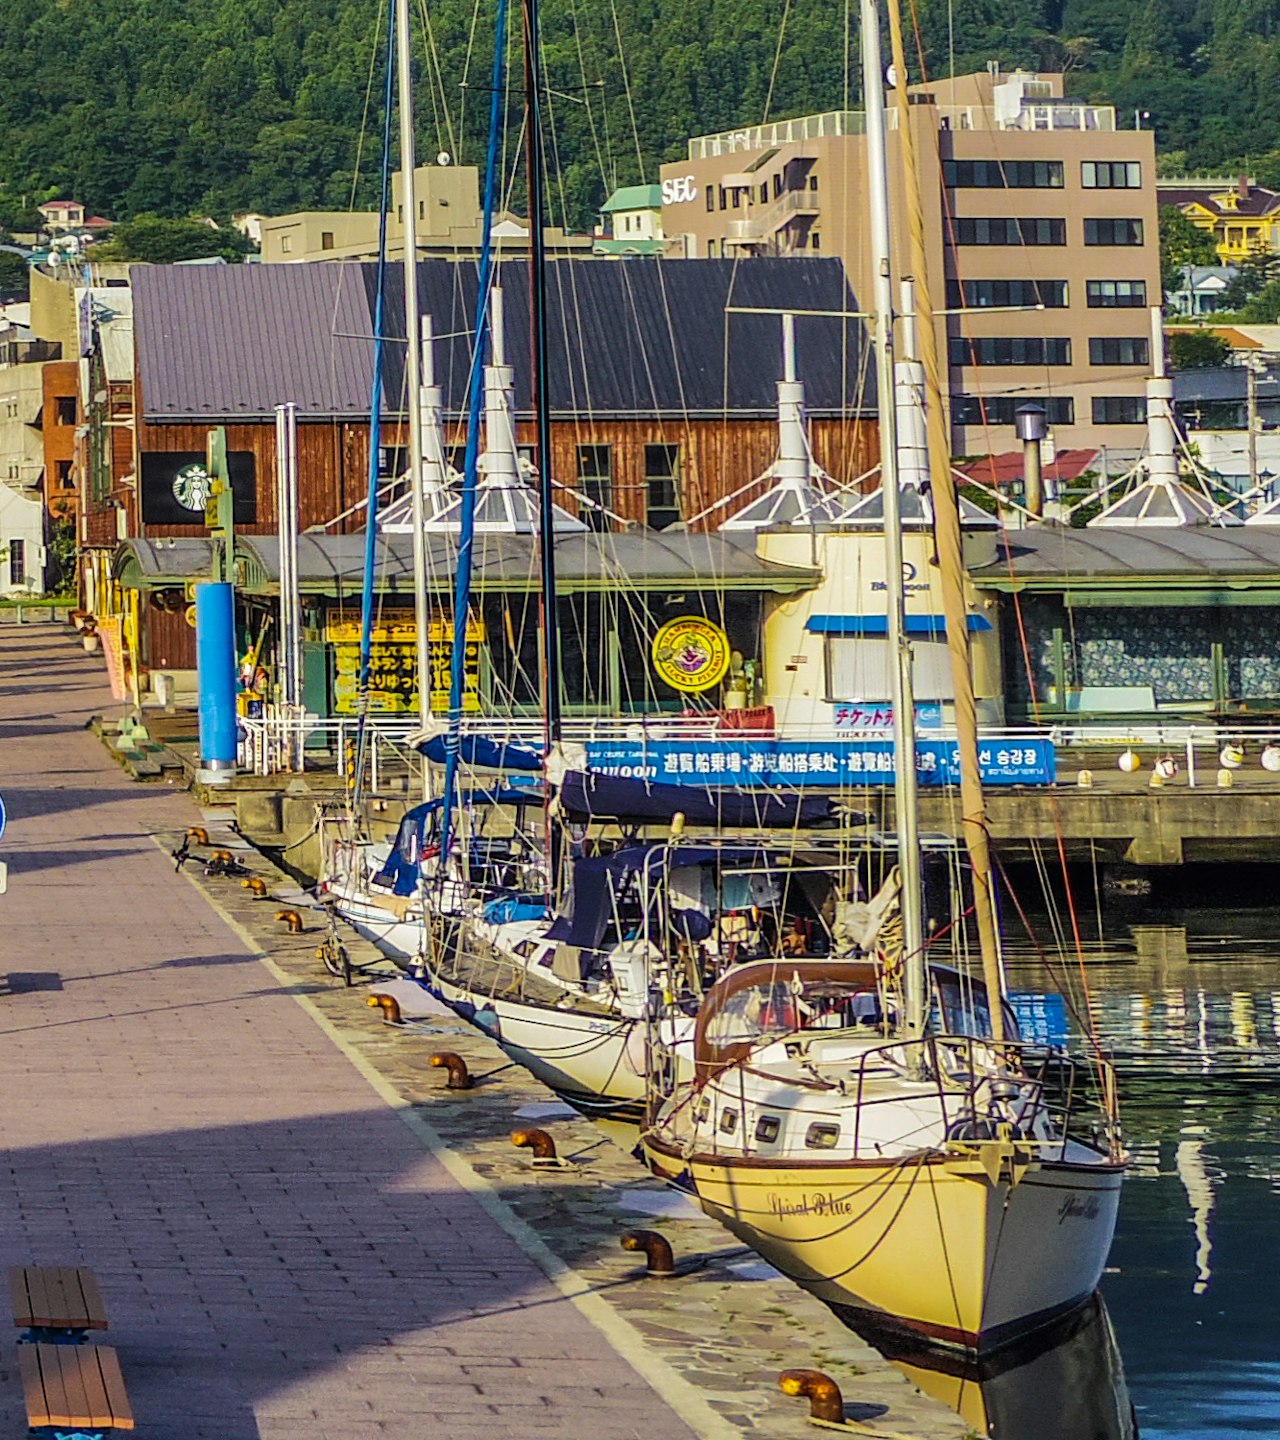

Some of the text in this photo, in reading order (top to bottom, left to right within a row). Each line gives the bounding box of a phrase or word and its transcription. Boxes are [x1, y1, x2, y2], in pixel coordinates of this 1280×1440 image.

[662, 175, 697, 205] SEC
[767, 1192, 852, 1222] Spiral Blue
